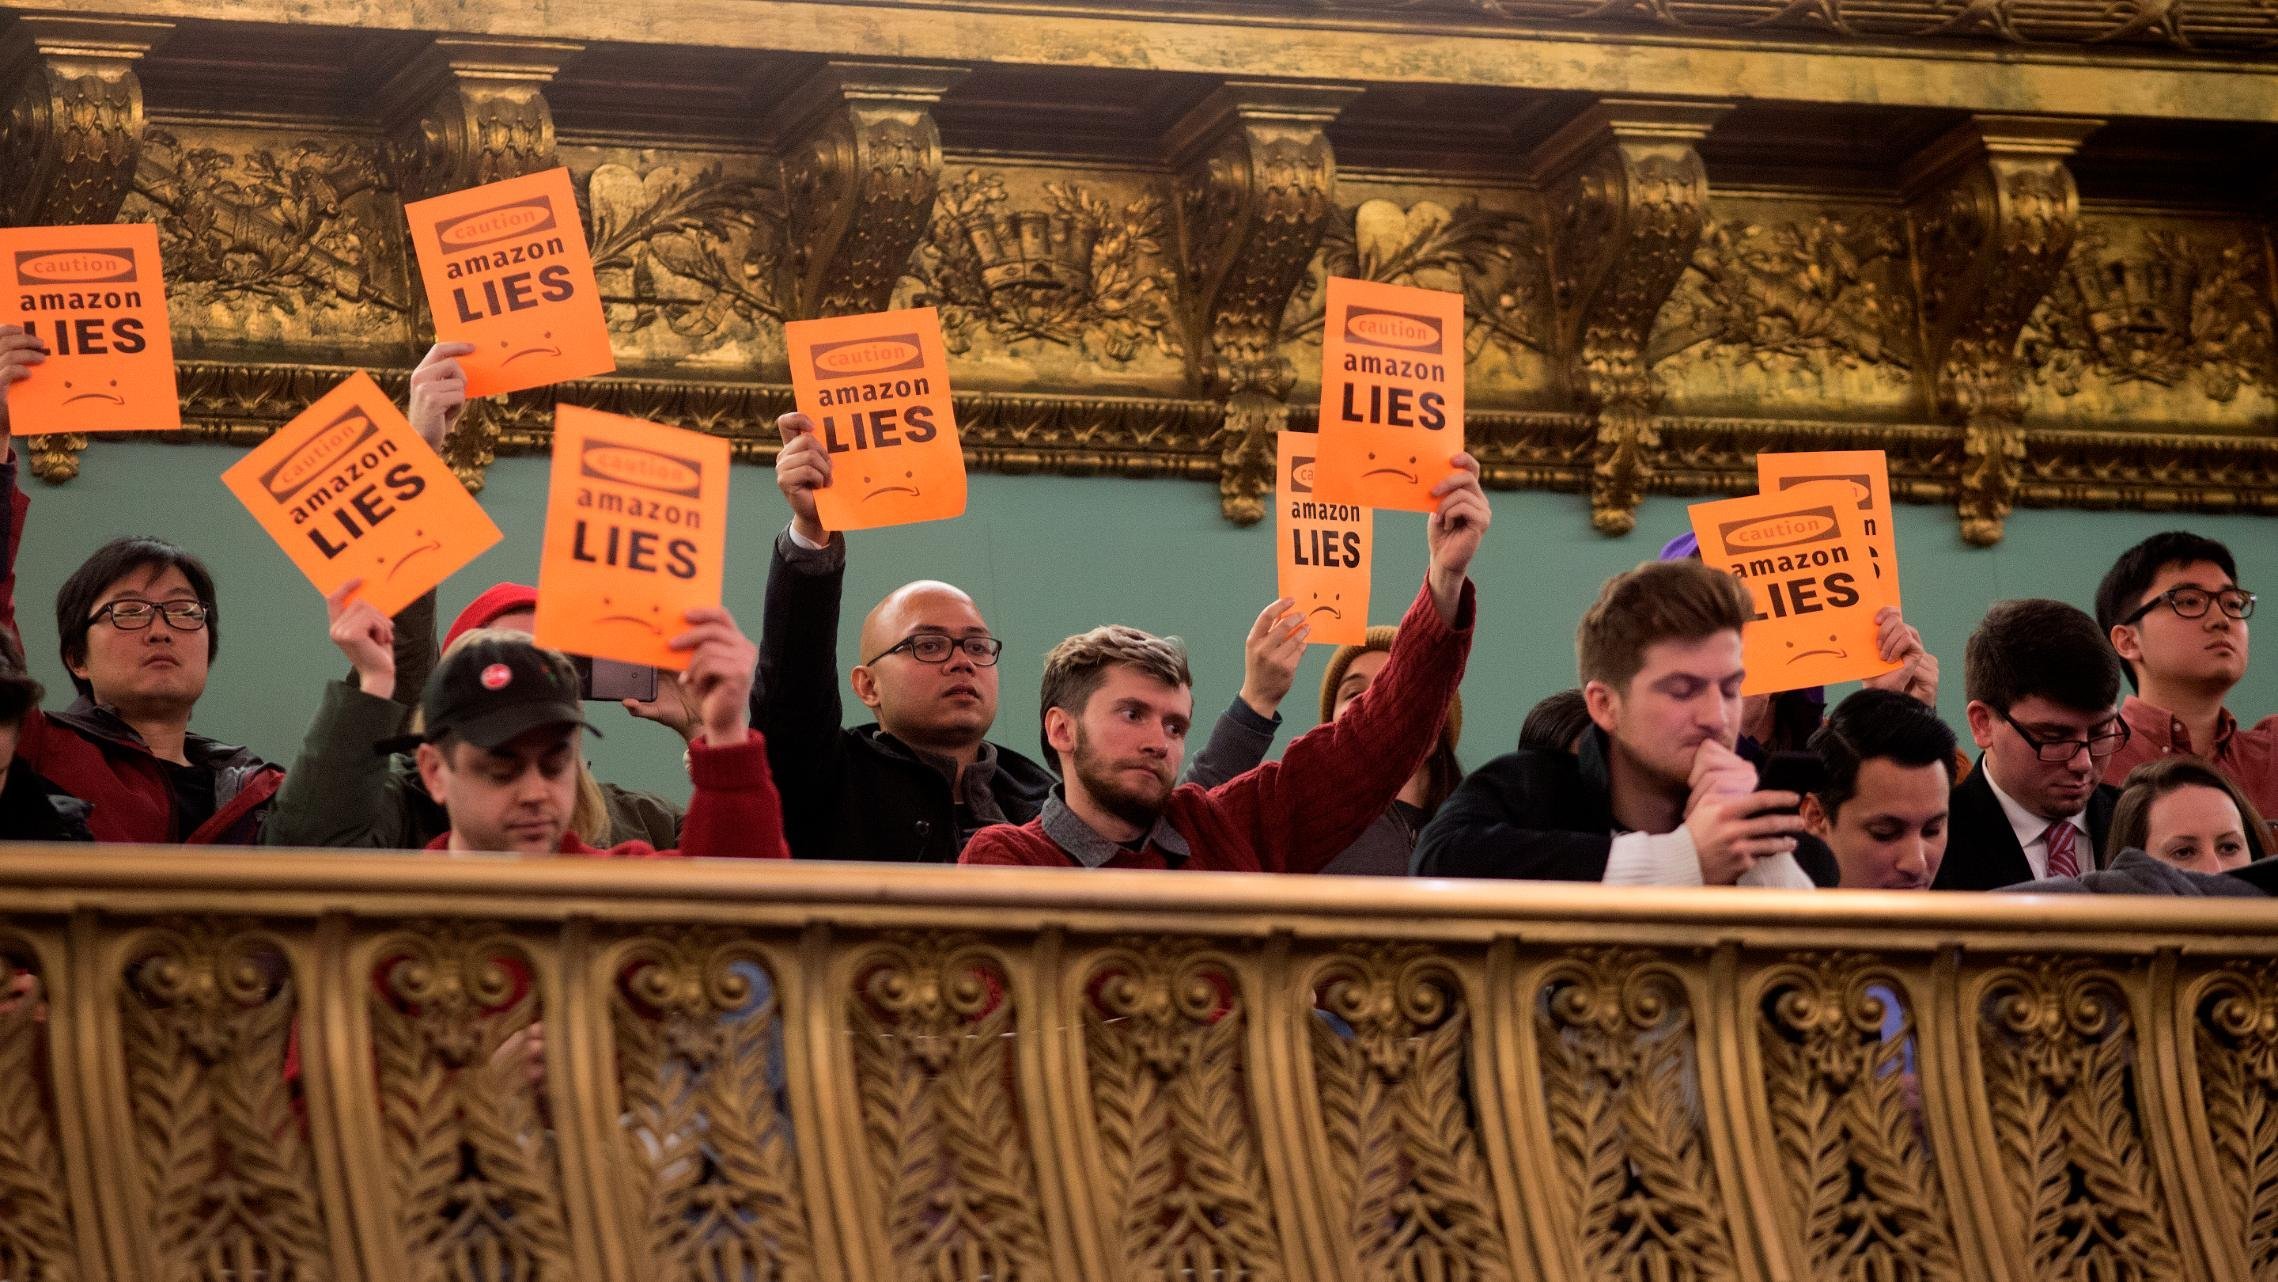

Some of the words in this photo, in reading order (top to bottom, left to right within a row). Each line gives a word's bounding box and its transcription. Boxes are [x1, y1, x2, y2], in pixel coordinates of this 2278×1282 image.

[455, 210, 535, 239] caution
[34, 256, 117, 273] caution
[446, 237, 565, 279] amazon
[20, 291, 141, 311] amazon
[453, 265, 574, 323] LIES
[1358, 319, 1427, 340] caution
[828, 345, 905, 367] caution
[1344, 353, 1445, 382] amazon
[819, 377, 930, 407] amazon
[1342, 382, 1446, 431] LIES
[823, 405, 937, 454] LIES
[282, 426, 354, 483] caution
[290, 439, 398, 524] amazon
[307, 463, 426, 560] LIES
[577, 488, 700, 529] amazon
[1292, 501, 1360, 522] amazon
[573, 520, 698, 579] LIES
[1293, 528, 1360, 568] LIES
[1738, 519, 1820, 543] caution
[1730, 546, 1849, 579] amazon
[1753, 572, 1859, 621] IES
